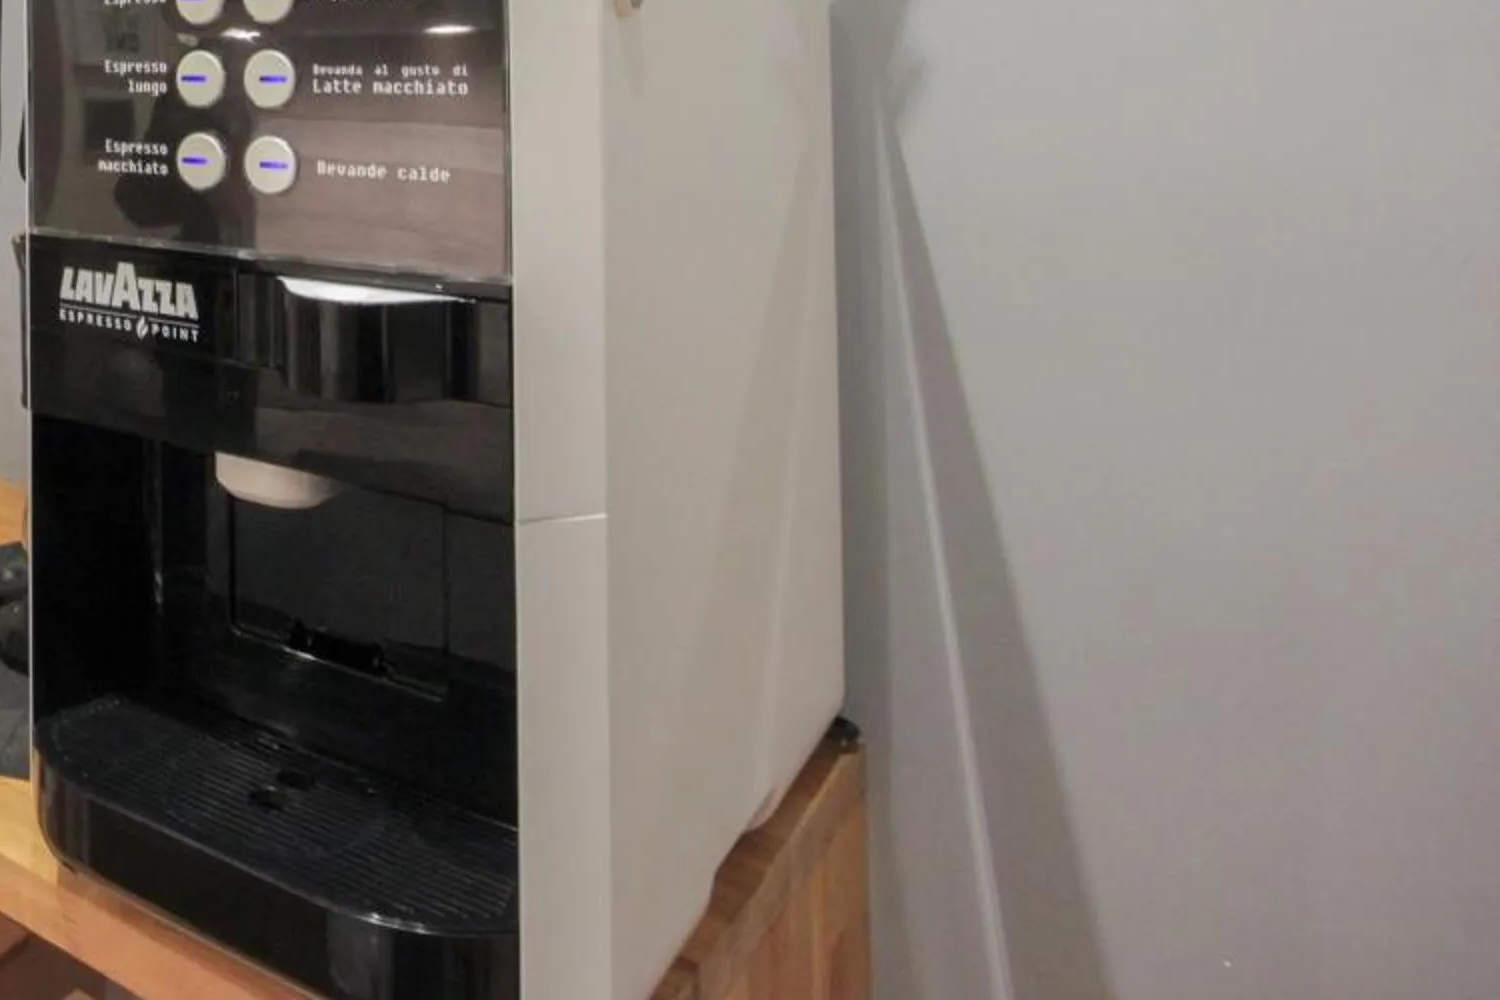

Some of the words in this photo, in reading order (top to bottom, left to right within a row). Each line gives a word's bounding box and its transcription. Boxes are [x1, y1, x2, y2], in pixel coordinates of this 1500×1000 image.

[104, 59, 167, 75] Espresso
[373, 63, 389, 76] al
[401, 64, 440, 78] gusto
[452, 63, 468, 76] di
[128, 79, 168, 96] lungo
[312, 78, 362, 94] Latte
[372, 79, 469, 95] macchiato
[104, 138, 169, 156] Espresso
[98, 159, 169, 177] macchiato
[316, 159, 387, 179] Bevande
[397, 165, 451, 183] calde
[59, 261, 199, 320] LAVAZZA
[59, 308, 132, 332] ESPRESSO
[151, 323, 199, 343] POINT
